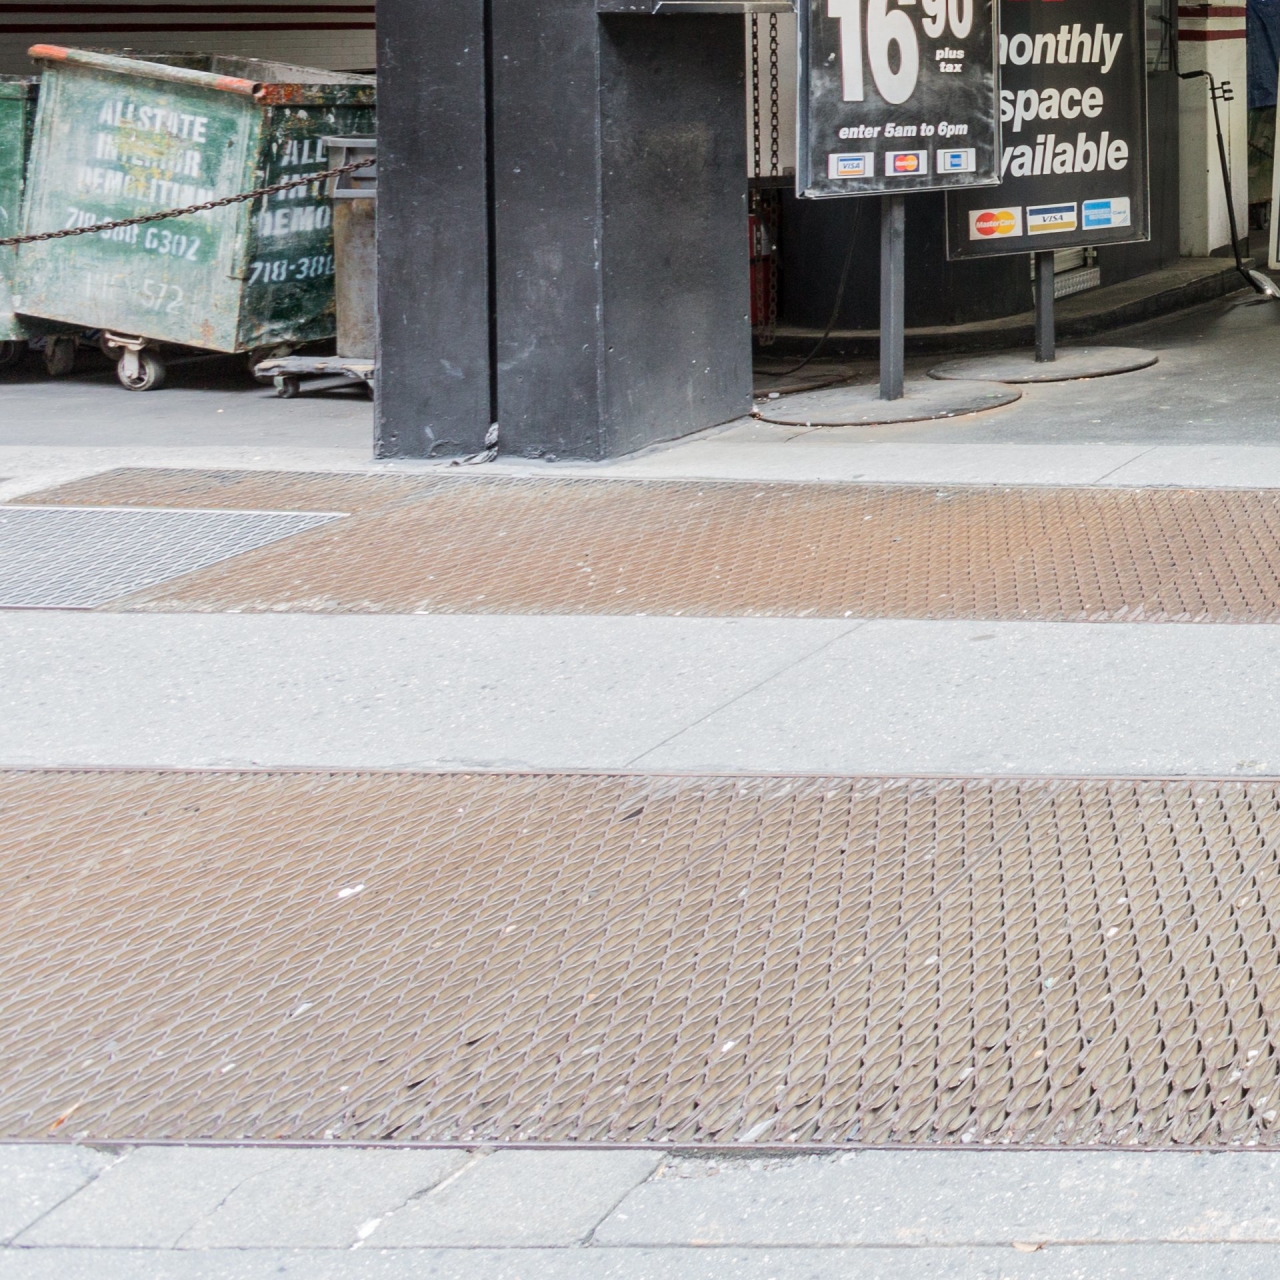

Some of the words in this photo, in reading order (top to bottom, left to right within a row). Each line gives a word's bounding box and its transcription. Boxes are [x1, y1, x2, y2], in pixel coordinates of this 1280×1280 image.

[935, 47, 965, 61] plus
[939, 62, 962, 73] tax
[1000, 85, 1104, 132] space
[839, 124, 880, 139] enter
[884, 123, 917, 138] 5am
[920, 123, 935, 137] to
[937, 121, 968, 138] 6pm
[1042, 215, 1064, 223] VISA
[144, 227, 201, 262] 6302
